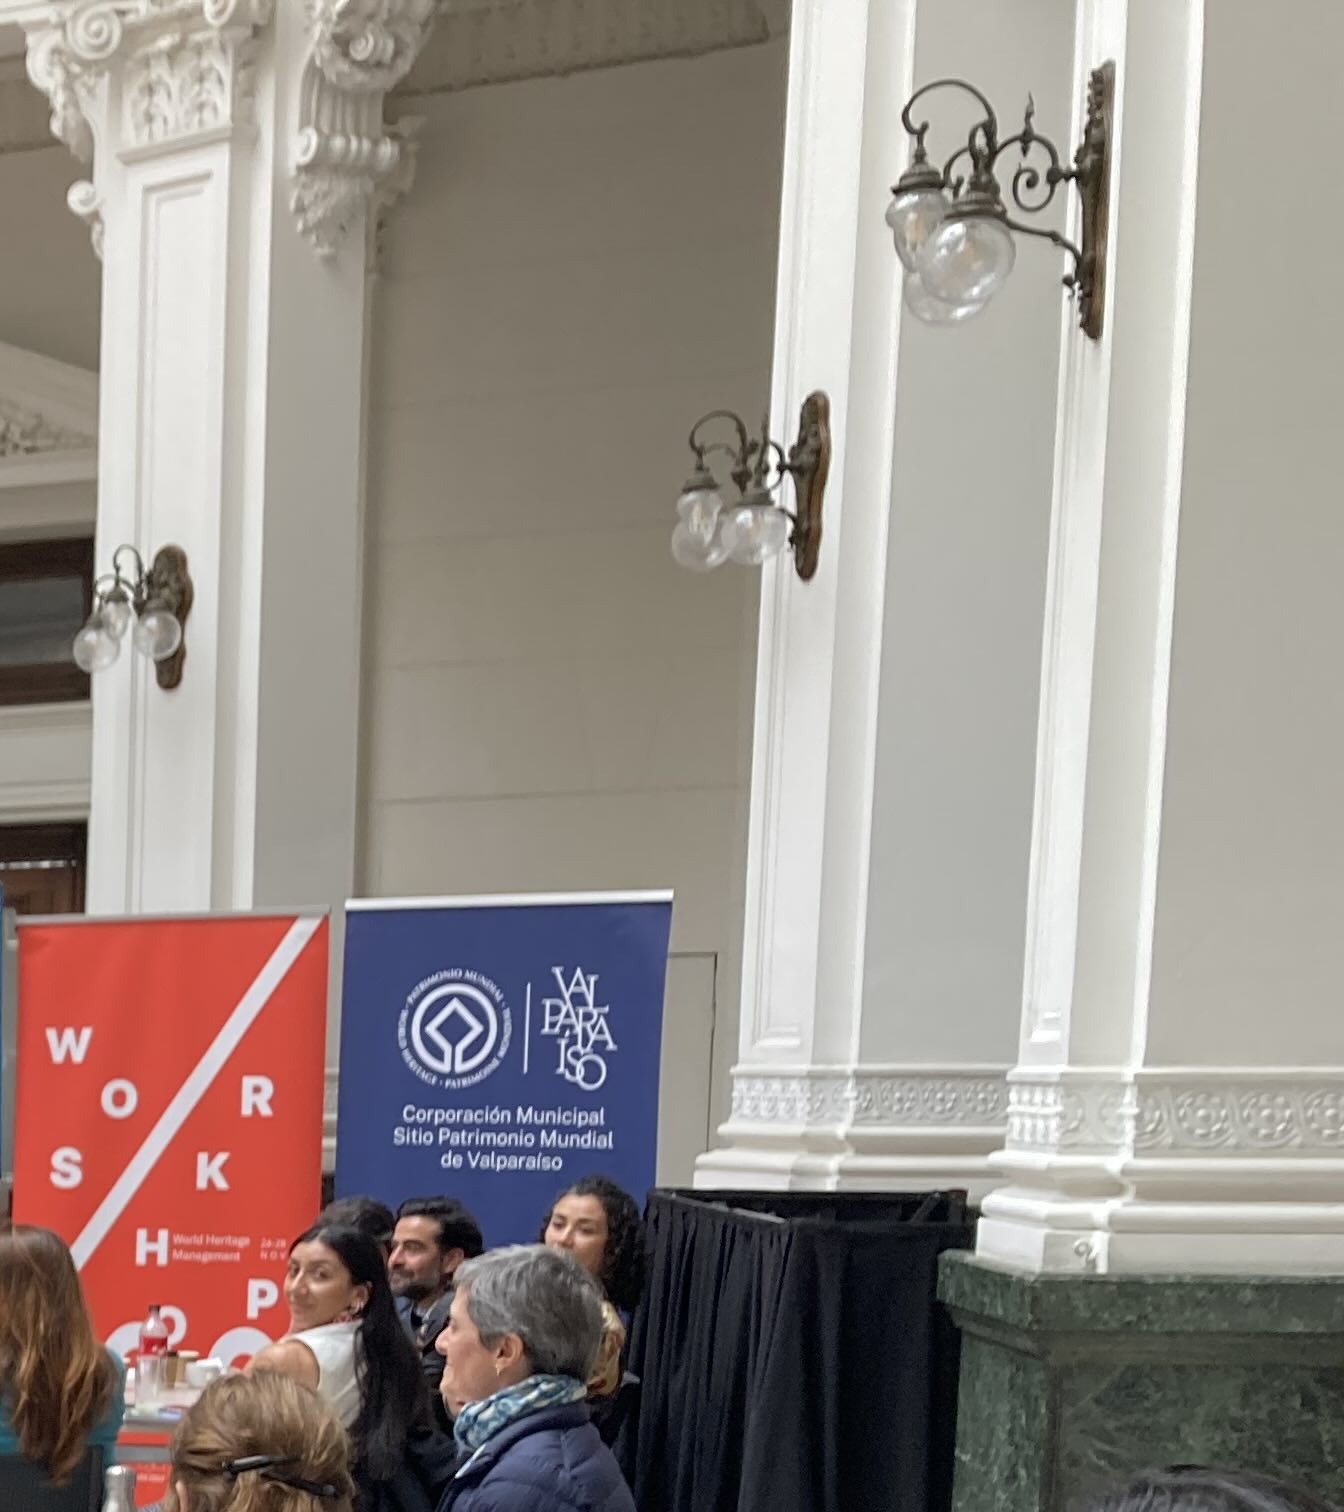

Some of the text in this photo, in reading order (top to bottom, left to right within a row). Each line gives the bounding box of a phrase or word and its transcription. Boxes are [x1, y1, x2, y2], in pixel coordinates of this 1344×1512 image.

[45, 1026, 92, 1065] W
[100, 1075, 273, 1118] O R
[403, 1104, 605, 1128] Corporación Municipal
[393, 1126, 614, 1150] Sitio Patrimonio Mundial
[50, 1147, 230, 1191] S K
[440, 1150, 563, 1172] de Valparaíso
[135, 1228, 169, 1267] H
[172, 1233, 250, 1249] World Heritage
[172, 1249, 241, 1263] Management
[247, 1278, 279, 1320] P
